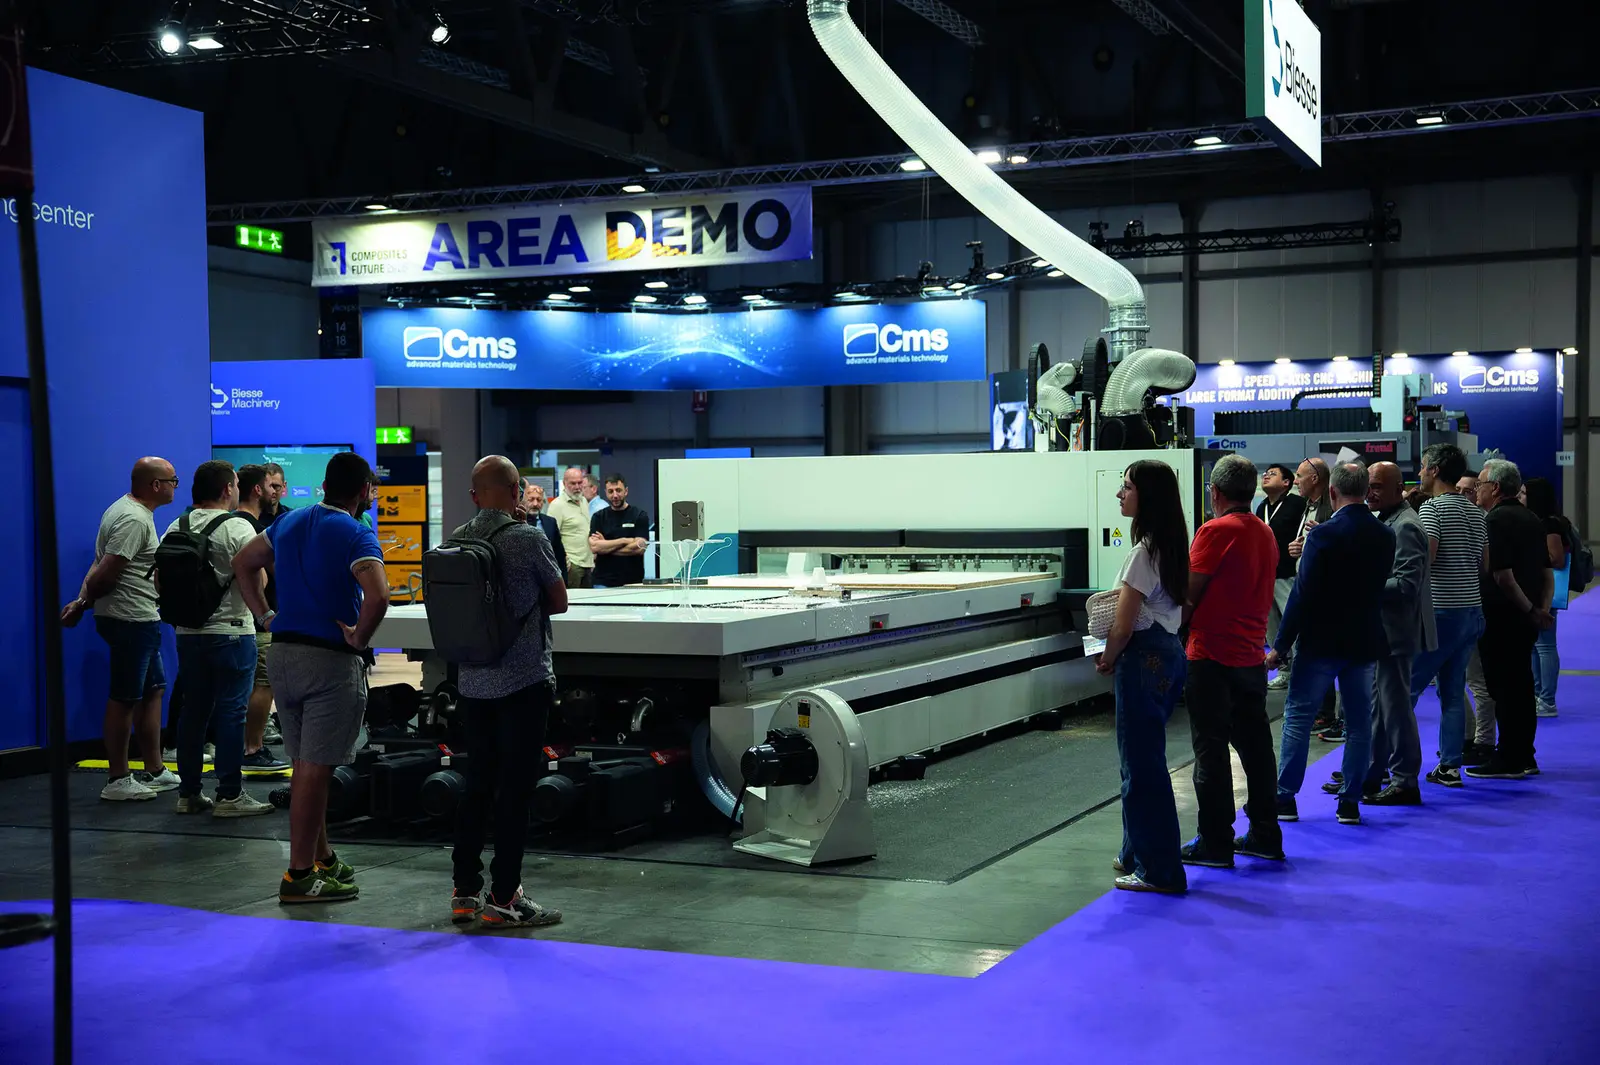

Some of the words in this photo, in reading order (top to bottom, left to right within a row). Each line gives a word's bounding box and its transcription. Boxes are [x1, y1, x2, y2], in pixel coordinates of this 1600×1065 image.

[1286, 40, 1317, 120] Biesse
[422, 214, 589, 271] AREA
[605, 199, 791, 261] DEMO
[351, 249, 408, 262] COMPOSITES
[351, 264, 385, 275] FUTURE
[335, 335, 347, 346] 18
[443, 328, 517, 359] Cms
[880, 323, 949, 353] Cms
[846, 356, 877, 364] advanced
[878, 355, 910, 363] materials
[911, 353, 948, 363] technology
[406, 360, 441, 368] advanced
[442, 360, 477, 368] materials
[478, 361, 517, 371] technology
[1243, 374, 1276, 387] SPEED
[1312, 371, 1335, 385] CNC
[1486, 366, 1539, 386] Cms
[232, 388, 263, 398] Biesse
[1186, 389, 1217, 404] LARGE
[1218, 388, 1256, 402] FORMAT
[232, 398, 280, 410] Machinery
[1221, 438, 1247, 449] Cms
